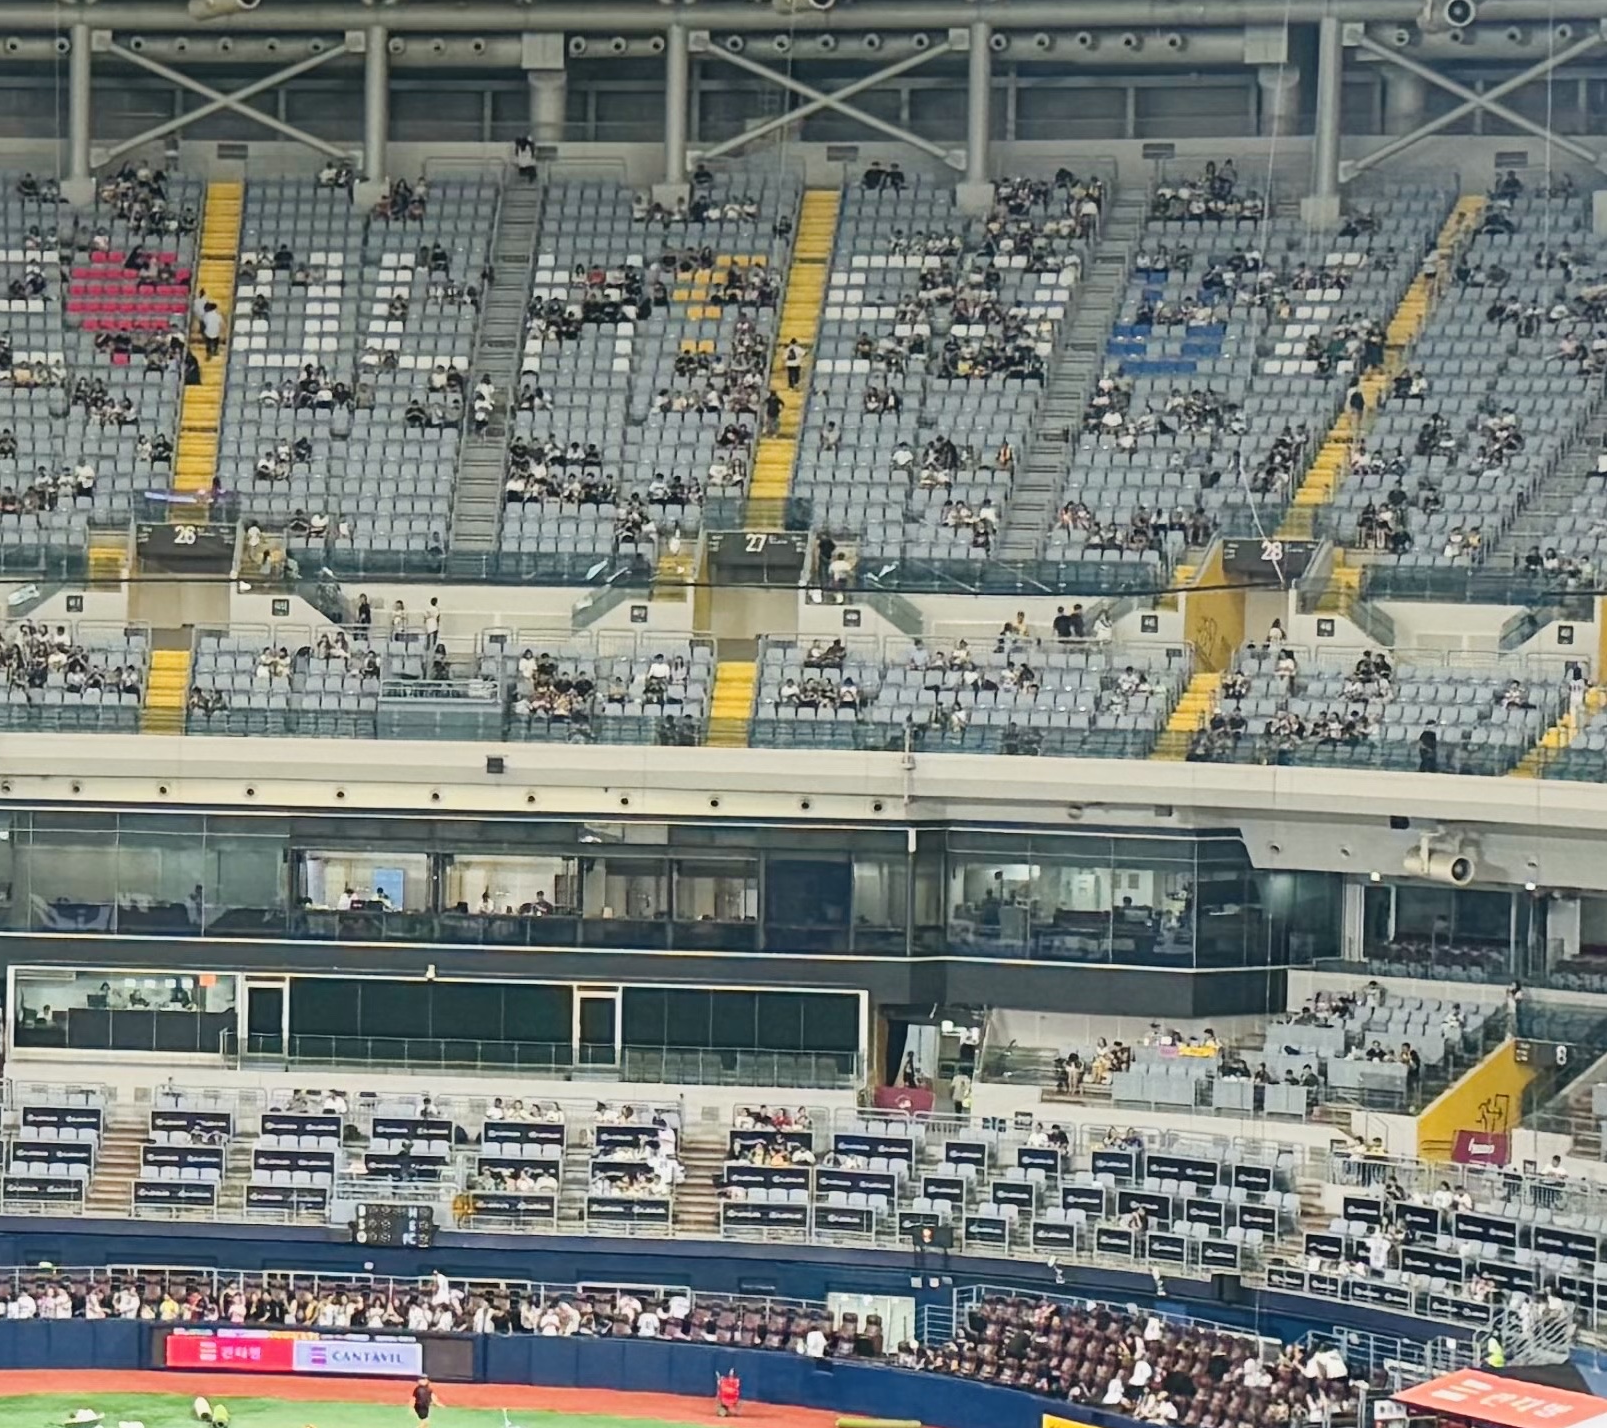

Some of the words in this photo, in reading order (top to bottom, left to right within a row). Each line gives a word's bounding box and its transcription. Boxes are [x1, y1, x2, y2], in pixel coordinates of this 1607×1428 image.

[174, 525, 196, 544] 26
[745, 533, 767, 552] 27
[1260, 540, 1283, 561] 28
[1556, 1045, 1567, 1065] 8
[332, 1350, 404, 1363] CANTAVIL
